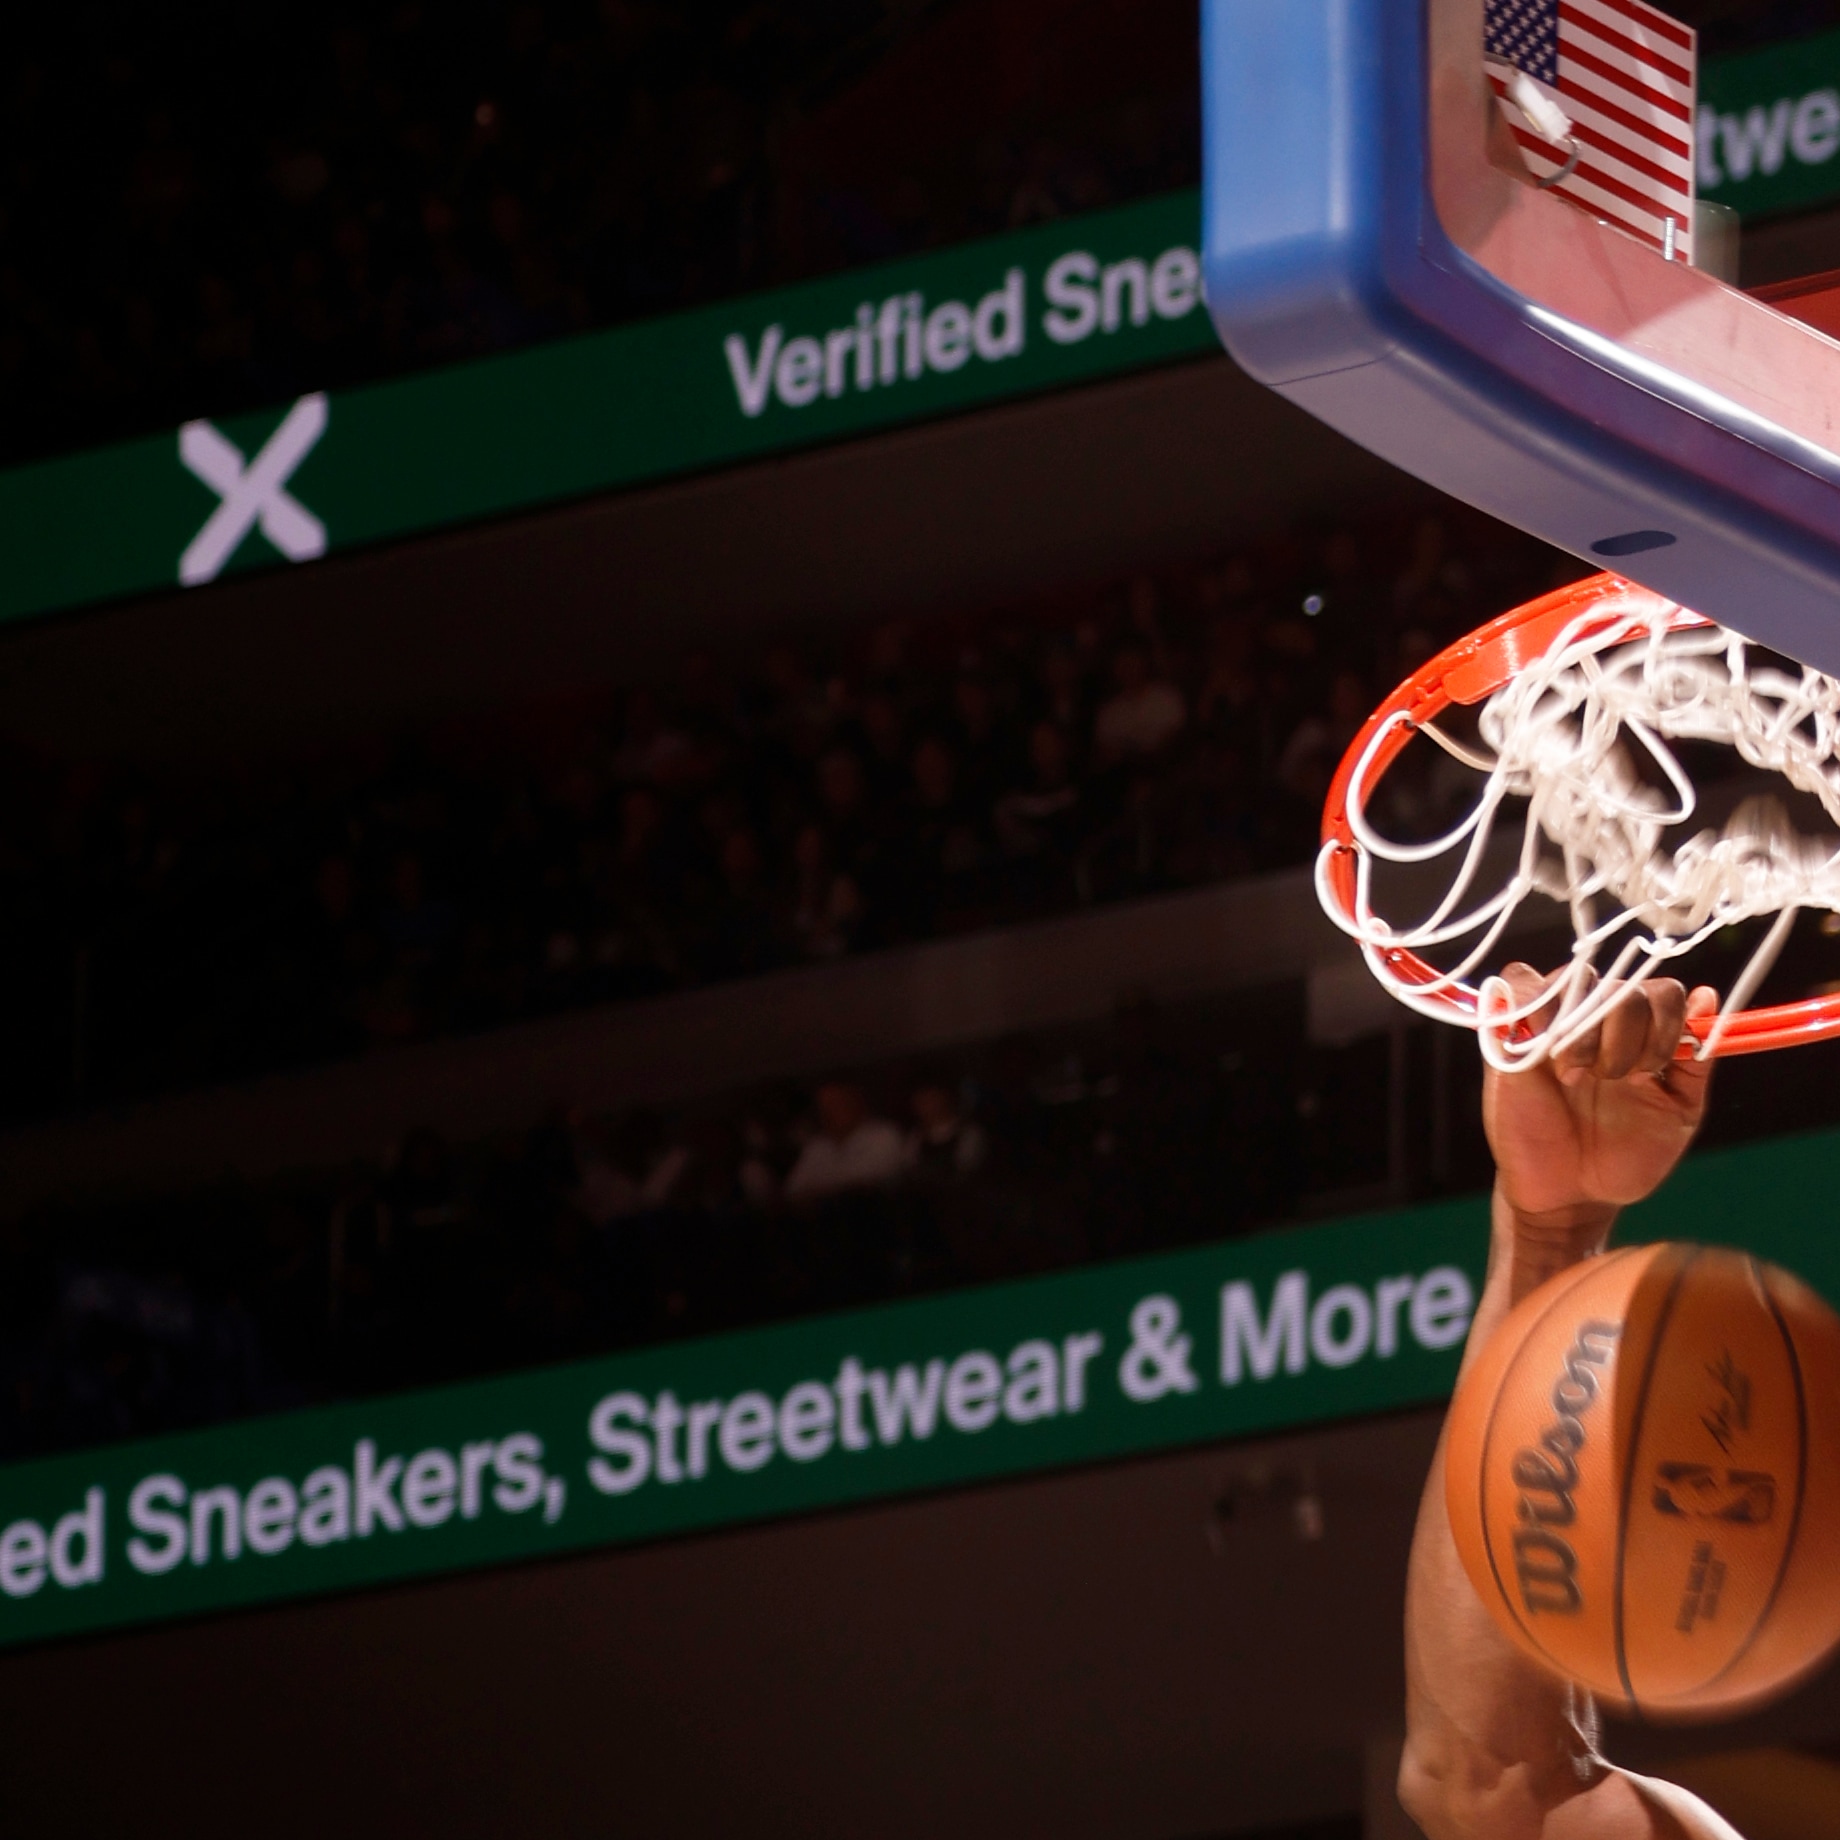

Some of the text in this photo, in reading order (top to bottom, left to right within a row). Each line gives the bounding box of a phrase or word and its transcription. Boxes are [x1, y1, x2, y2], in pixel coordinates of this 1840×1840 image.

[725, 245, 1207, 417] Verified Sne
[178, 390, 328, 587] X
[126, 1438, 566, 1576] Sneakers,
[587, 1326, 1104, 1494] Streetwear
[1116, 1293, 1198, 1402] &
[1218, 1266, 1475, 1389] More
[1511, 1319, 1623, 1617] Wilson
